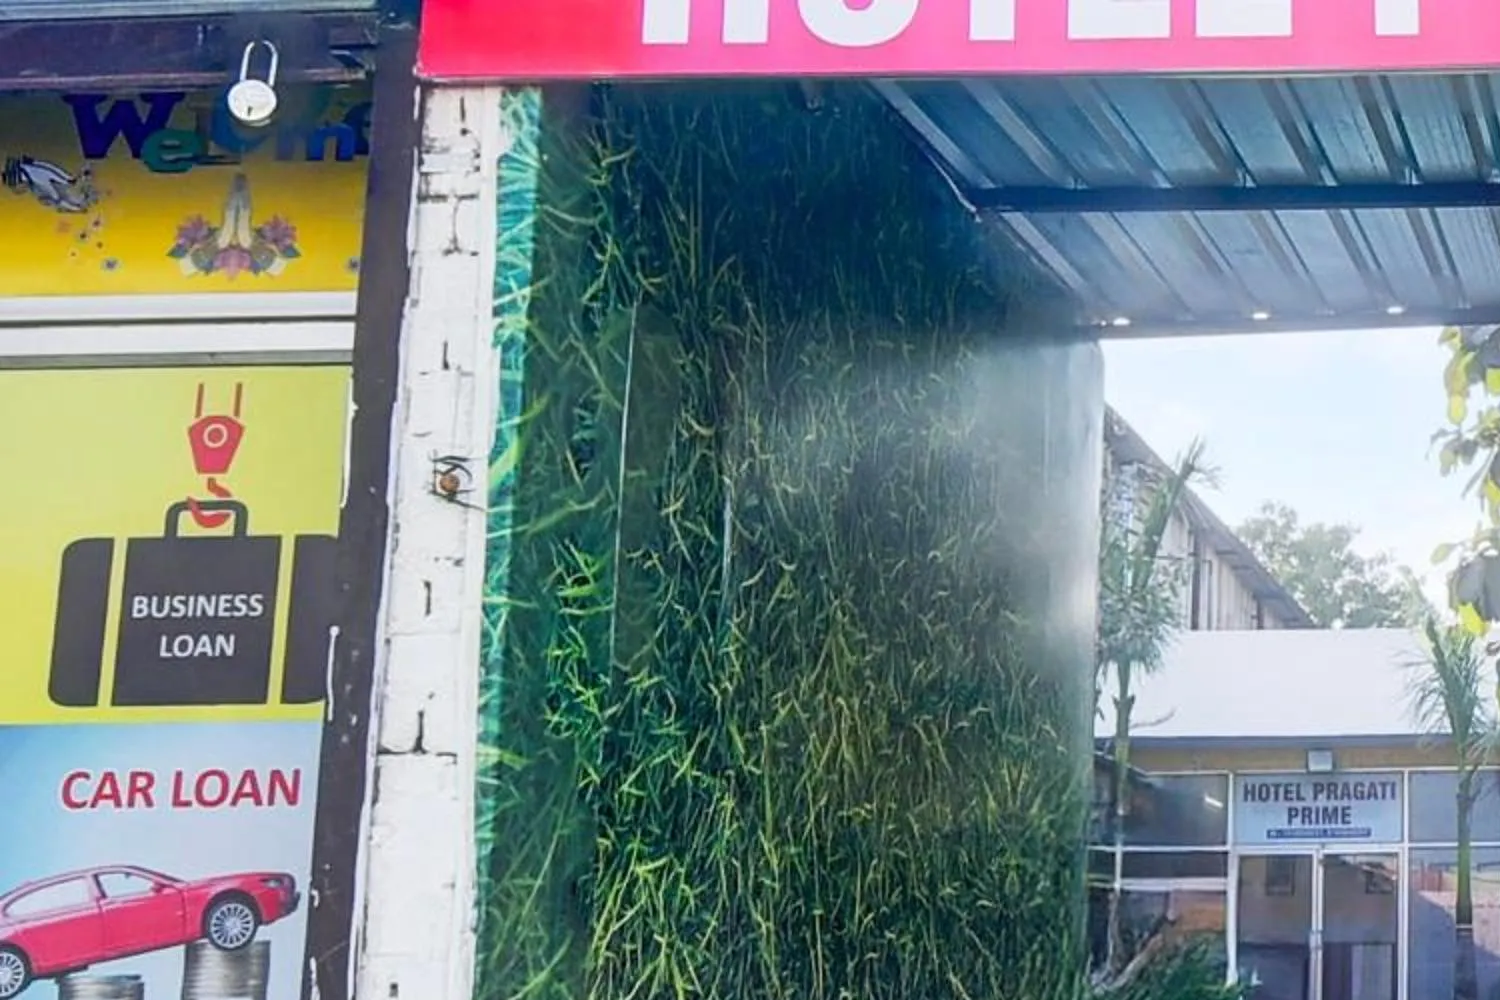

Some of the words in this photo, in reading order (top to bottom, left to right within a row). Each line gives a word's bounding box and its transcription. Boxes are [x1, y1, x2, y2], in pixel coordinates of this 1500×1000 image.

[131, 594, 264, 618] BUSINESS
[159, 634, 235, 658] LOAN
[62, 771, 156, 810] CAR
[171, 768, 302, 808] LOAN
[1243, 782, 1304, 802] HOTEL
[1312, 781, 1396, 801] PRAGATI
[1287, 806, 1352, 825] PRIME
